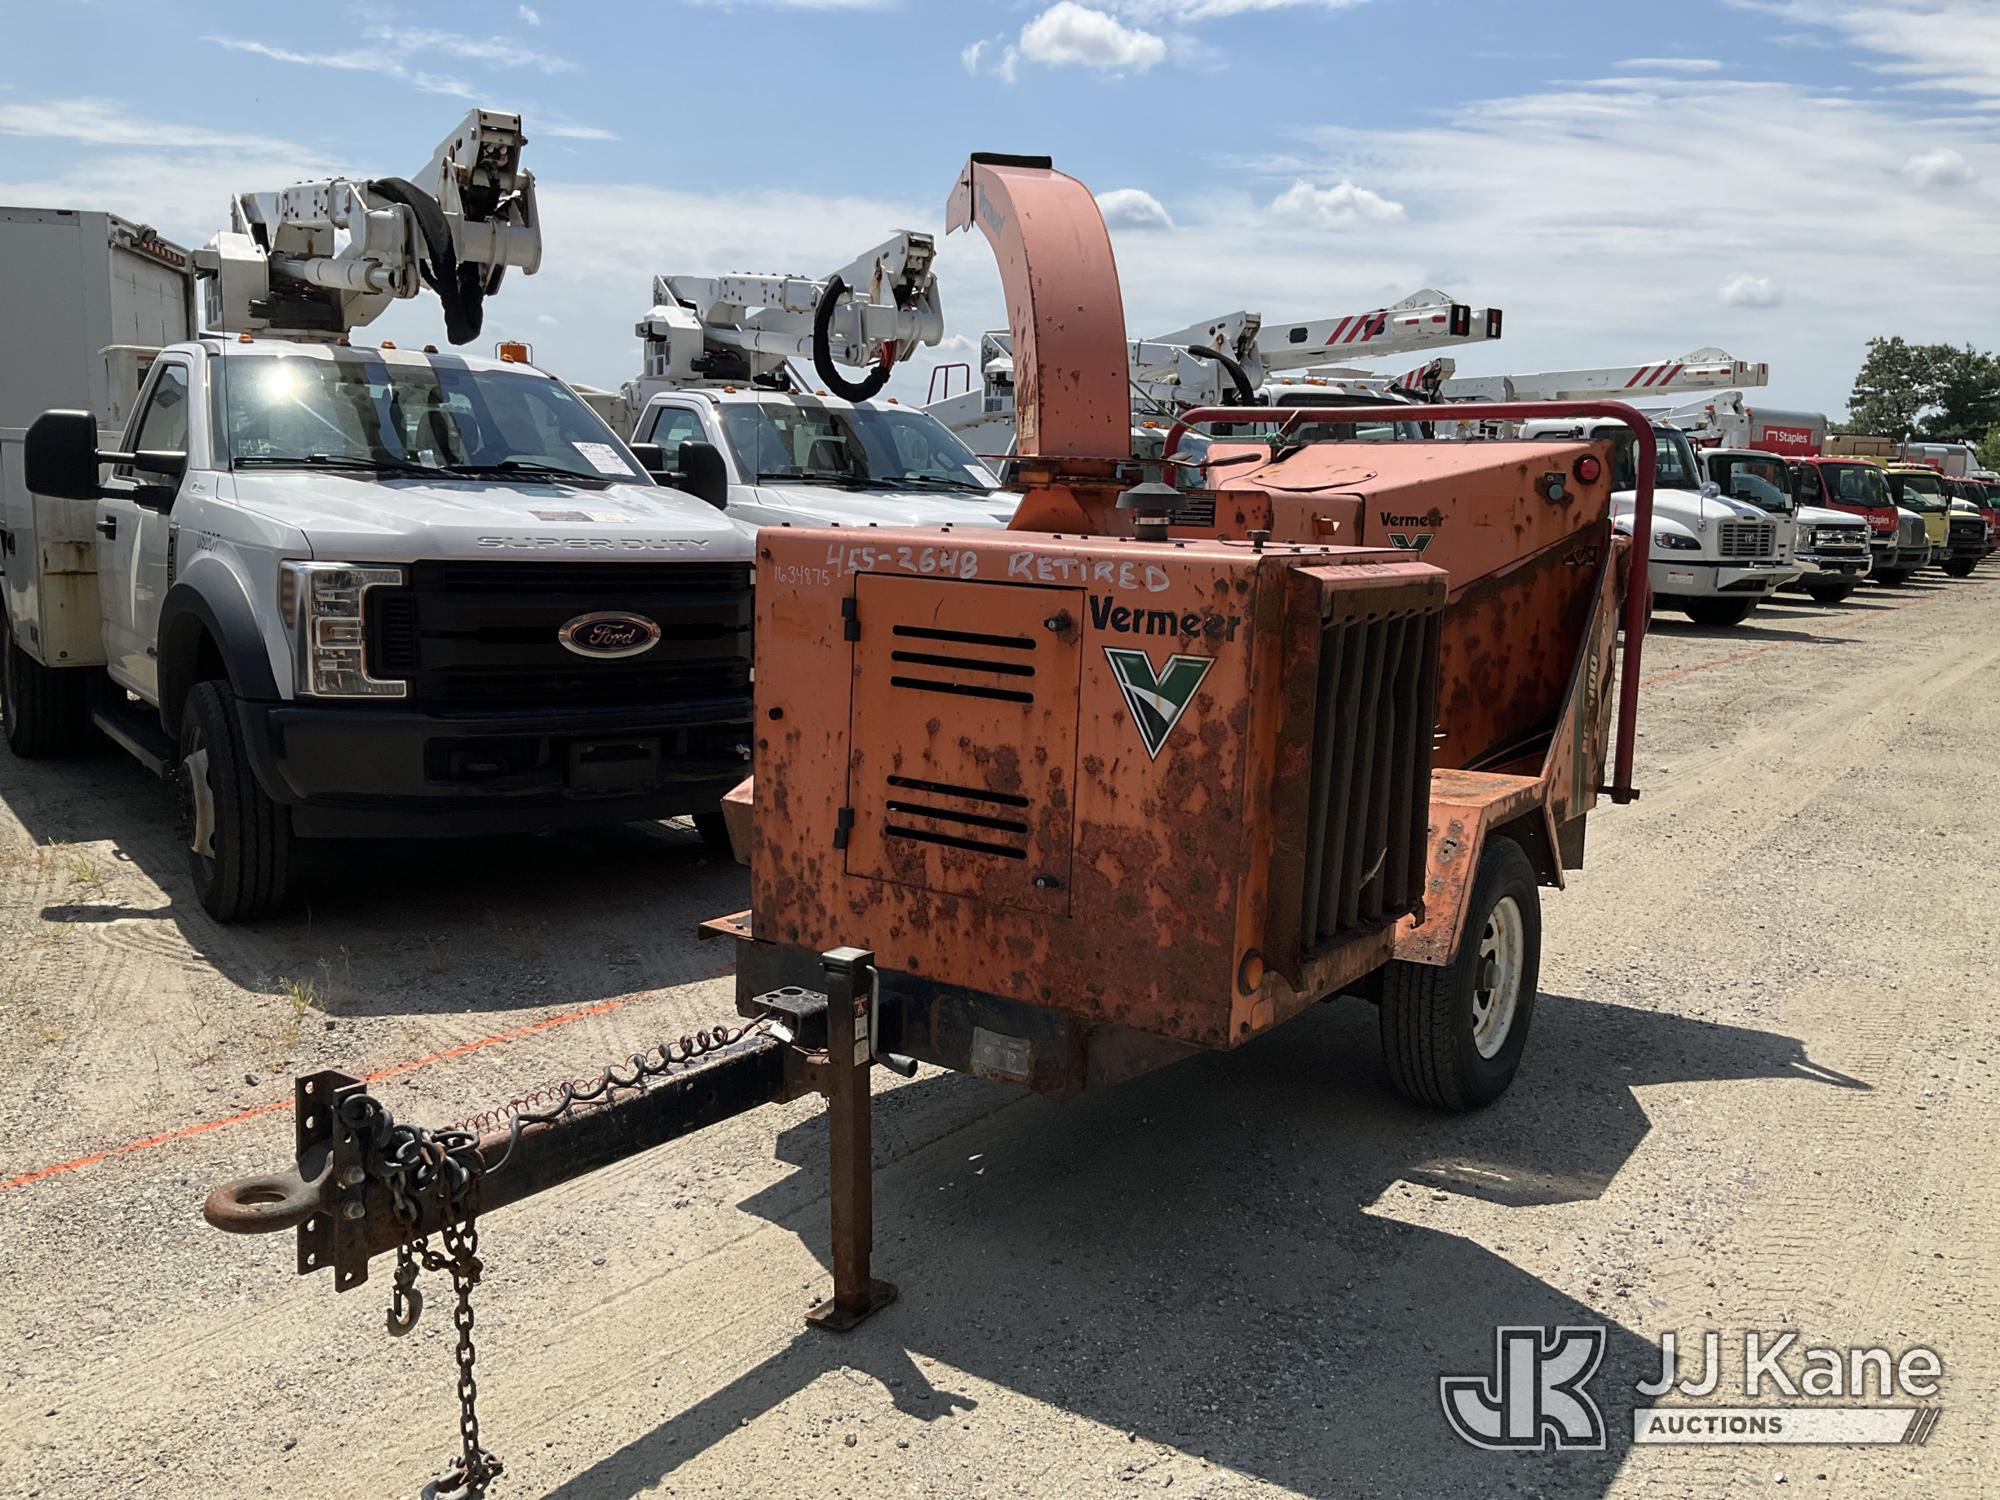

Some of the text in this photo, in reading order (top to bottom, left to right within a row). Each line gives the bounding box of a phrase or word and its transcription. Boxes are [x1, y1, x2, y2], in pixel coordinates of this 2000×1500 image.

[1779, 431, 1808, 446] Staples
[1380, 511, 1444, 528] Vermeer
[477, 536, 711, 551] SUPER DUTY
[774, 565, 831, 586] 1634875
[1008, 551, 1170, 593] RETIRED
[1089, 595, 1241, 642] Vermeer
[589, 623, 636, 646] Ford
